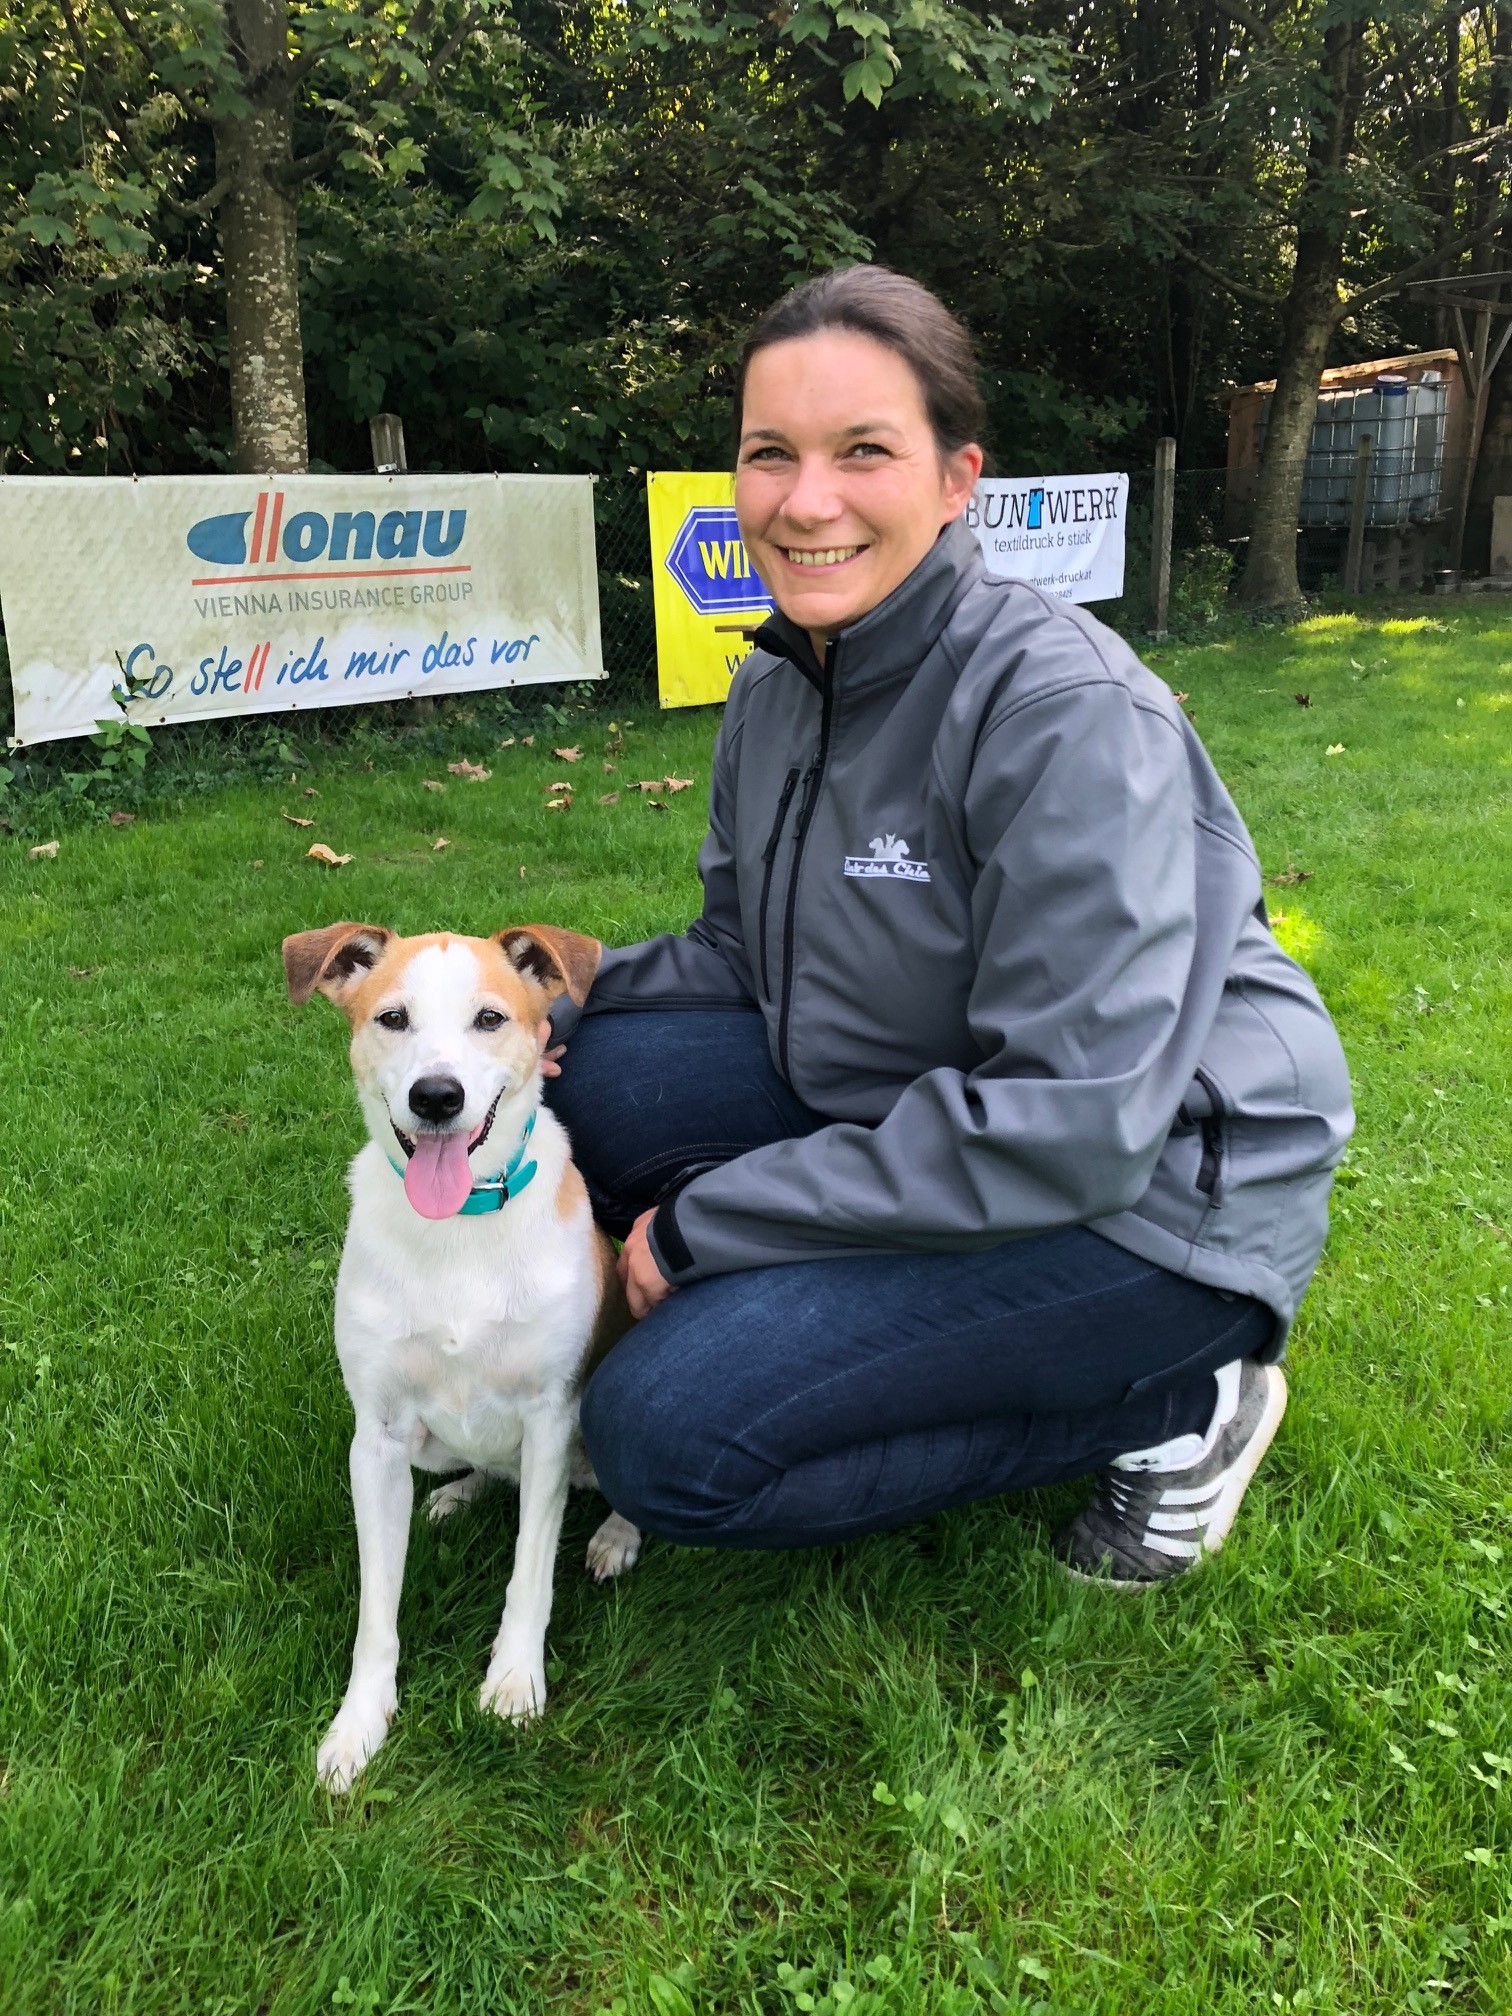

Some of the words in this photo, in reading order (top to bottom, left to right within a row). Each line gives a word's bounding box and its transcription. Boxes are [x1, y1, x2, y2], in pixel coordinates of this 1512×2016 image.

[994, 533, 1054, 553] textildruck
[1057, 531, 1065, 547] &
[1068, 529, 1092, 545] stick
[194, 591, 282, 619] VIENNA
[288, 586, 405, 612] INSURANCE
[410, 582, 474, 605] GROUP
[190, 640, 271, 696] stell
[276, 636, 329, 685] ich
[344, 641, 411, 680] mir
[421, 630, 478, 674] das
[490, 634, 541, 665] vor
